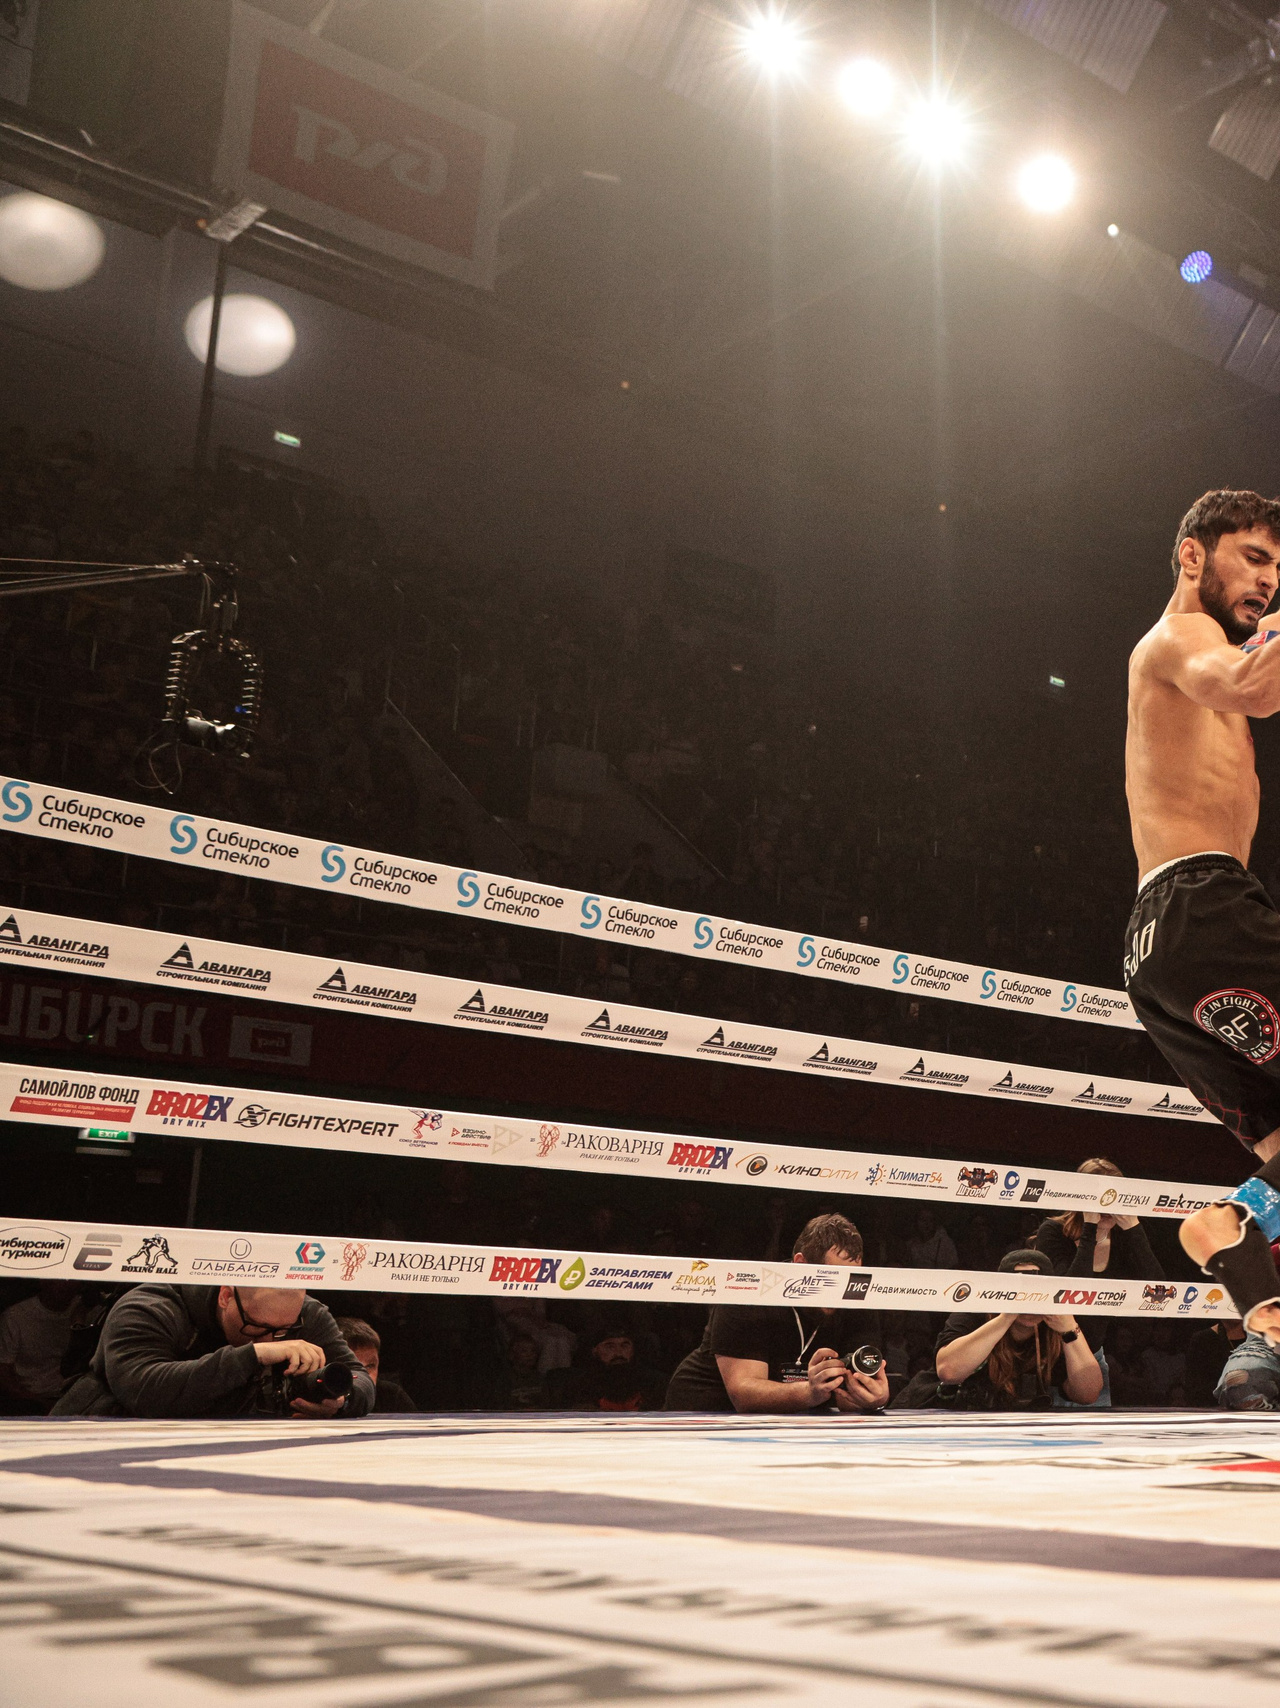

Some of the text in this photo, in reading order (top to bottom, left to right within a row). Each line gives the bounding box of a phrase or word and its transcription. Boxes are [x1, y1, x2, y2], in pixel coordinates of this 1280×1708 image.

[43, 795, 146, 829] Сибирское
[38, 811, 113, 839] Стекло
[206, 828, 300, 858] Сибирское
[202, 844, 270, 869] Стекло
[354, 857, 438, 885] Сибирское
[350, 872, 411, 895] Стекло
[487, 883, 564, 909] Сибирское
[484, 898, 540, 919] Стекло
[608, 907, 678, 930] Сибирское
[605, 920, 655, 940] Стекло
[720, 927, 784, 949] Сибирское
[27, 935, 110, 959] АВАНГАРД
[716, 941, 763, 959] Стекло
[820, 946, 880, 967] Сибирское
[0, 947, 106, 969] ОИТЕЛЬНАЯ КОМПАНИЯ
[816, 958, 860, 976] Стекло
[156, 970, 268, 992] СТРОИТЕЛЬНАЯ КОМПАНИЯ
[198, 961, 271, 983] АВАНГАРД
[914, 964, 969, 983] Сибирское
[910, 975, 951, 991] Стекло
[1001, 979, 1052, 998] Сибирское
[313, 992, 412, 1013] СТРОИТЕЛЬНАЯ КОМПАНИЯ
[350, 984, 417, 1005] АВАНГАРД
[997, 990, 1034, 1006] Стекло
[1081, 994, 1128, 1011] Сибирское
[1208, 1000, 1221, 1011] IN
[1223, 997, 1259, 1010] FIGHT
[489, 1005, 549, 1024] АВАНГАРД
[1077, 1004, 1112, 1018] Стекло
[613, 1023, 669, 1041] АВАНГАРД
[1219, 1013, 1249, 1044] RF
[727, 1040, 778, 1056] АВАНГАРД
[830, 1056, 878, 1071] АВАНГАРД
[927, 1070, 969, 1083] АВАНГАРД
[20, 1078, 140, 1104] САМОЙЛОВ ФОНД
[1014, 1083, 1054, 1095] АВАНГАРД
[146, 1090, 234, 1122] BROZEX
[1095, 1093, 1133, 1105] АВАНГАРД
[163, 1118, 206, 1128] DRY MIX
[267, 1112, 399, 1137] FIGHTEXPERT
[566, 1133, 664, 1156] РАКОВАРНЯ
[667, 1142, 734, 1170] BROZEX
[778, 1164, 859, 1180] КИНОСИТИ
[889, 1167, 943, 1184] Климат54
[956, 1183, 991, 1198] ШТОРМ
[1025, 1187, 1097, 1201] ГИС Недвижимость
[2, 1249, 50, 1260] гурман
[373, 1252, 486, 1273] РАКОВАРНЯ
[121, 1265, 178, 1275] BOXING HALL
[391, 1273, 412, 1281] РАКИ
[420, 1275, 430, 1283] НЕ
[431, 1275, 460, 1284] ТОЛЬКО
[489, 1256, 562, 1283] BROZEX
[590, 1267, 673, 1279] ЗАПРАВЛЯЕМ
[523, 1283, 539, 1291] MIX
[585, 1279, 653, 1290] ДЕНЬГАМИ
[847, 1282, 937, 1296] ГИС Недвижимость
[980, 1289, 1049, 1302] КИНОСИТИ
[1097, 1288, 1127, 1301] СТРОЙ
